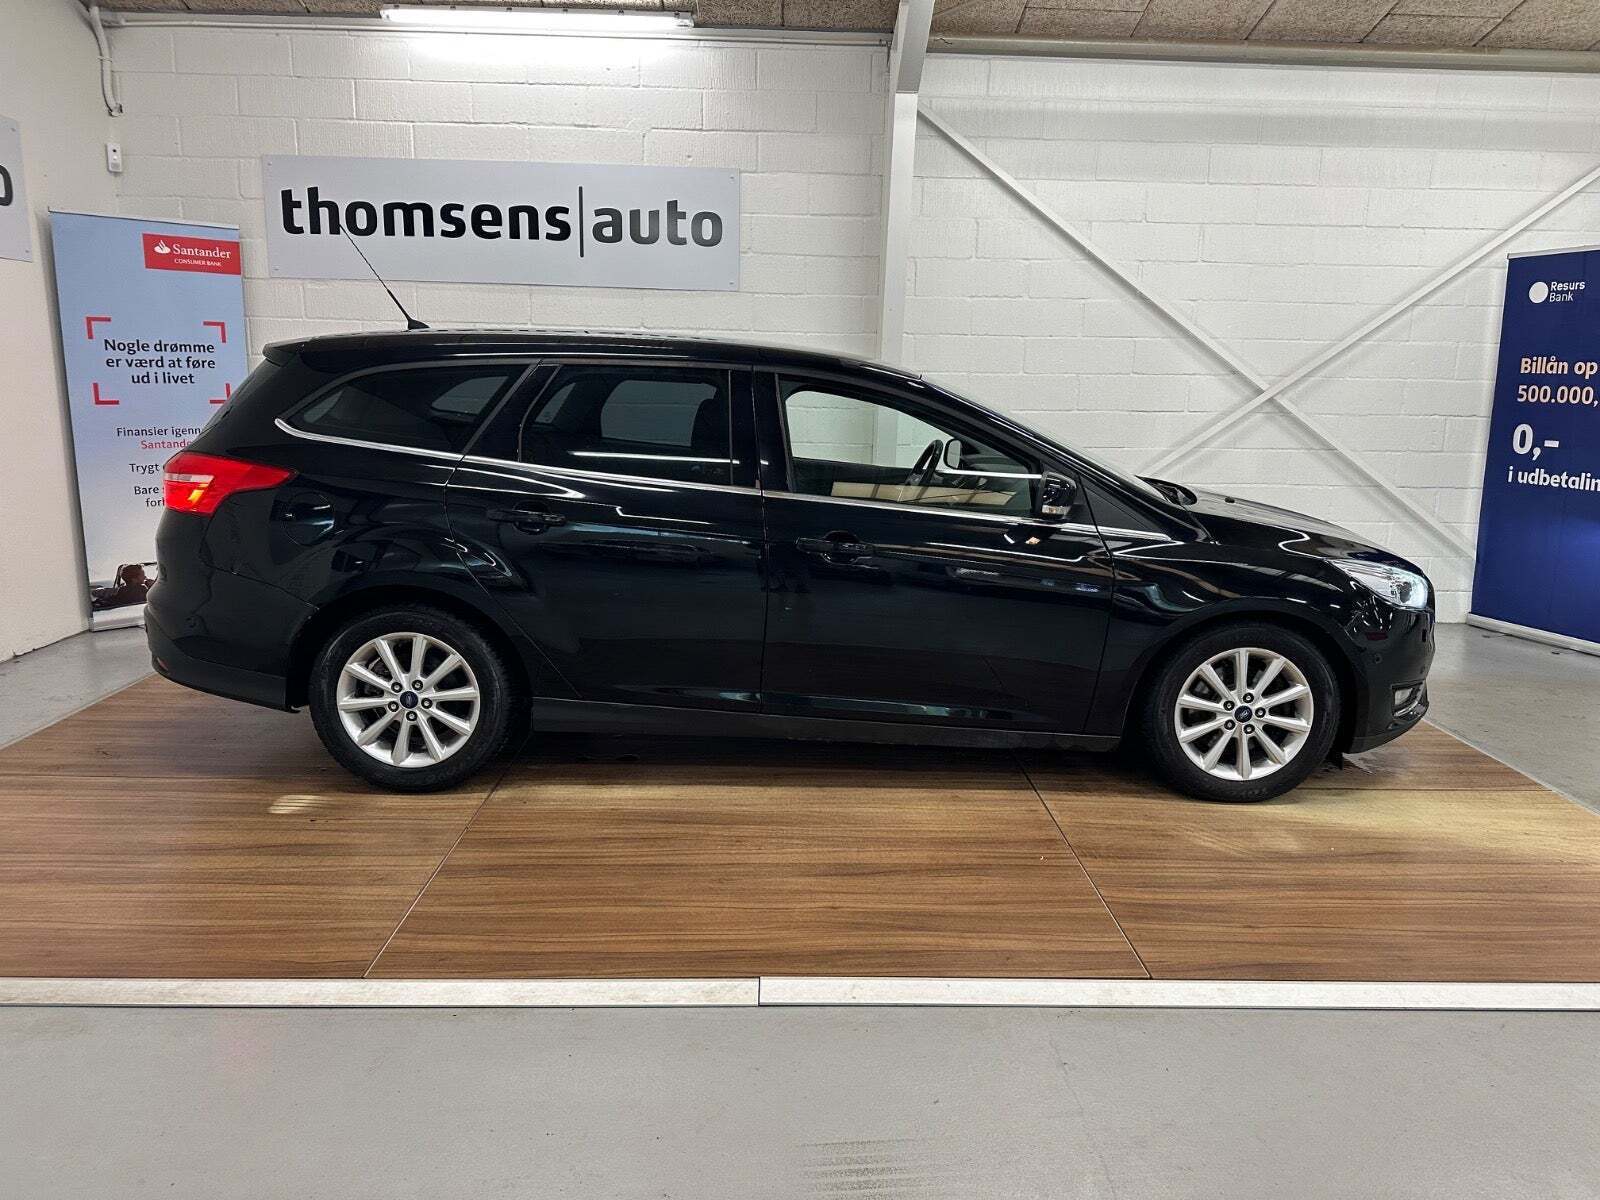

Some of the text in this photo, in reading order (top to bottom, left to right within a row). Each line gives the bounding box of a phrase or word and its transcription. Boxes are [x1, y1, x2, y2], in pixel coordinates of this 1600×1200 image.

[172, 243, 232, 259] Santander
[174, 258, 222, 267] CONSUMER BANK
[1550, 280, 1586, 292] Resurs
[1549, 291, 1574, 303] Bank
[104, 338, 215, 354] Nogle drømme
[106, 354, 216, 370] er værd at føre
[1520, 355, 1598, 380] Billån op
[131, 372, 195, 385] ud i livet
[1517, 385, 1599, 408] 500.000,
[116, 427, 168, 437] Finansier
[129, 463, 160, 474] Trygt
[1507, 465, 1600, 492] i udbetalin
[134, 486, 160, 495] Bare
